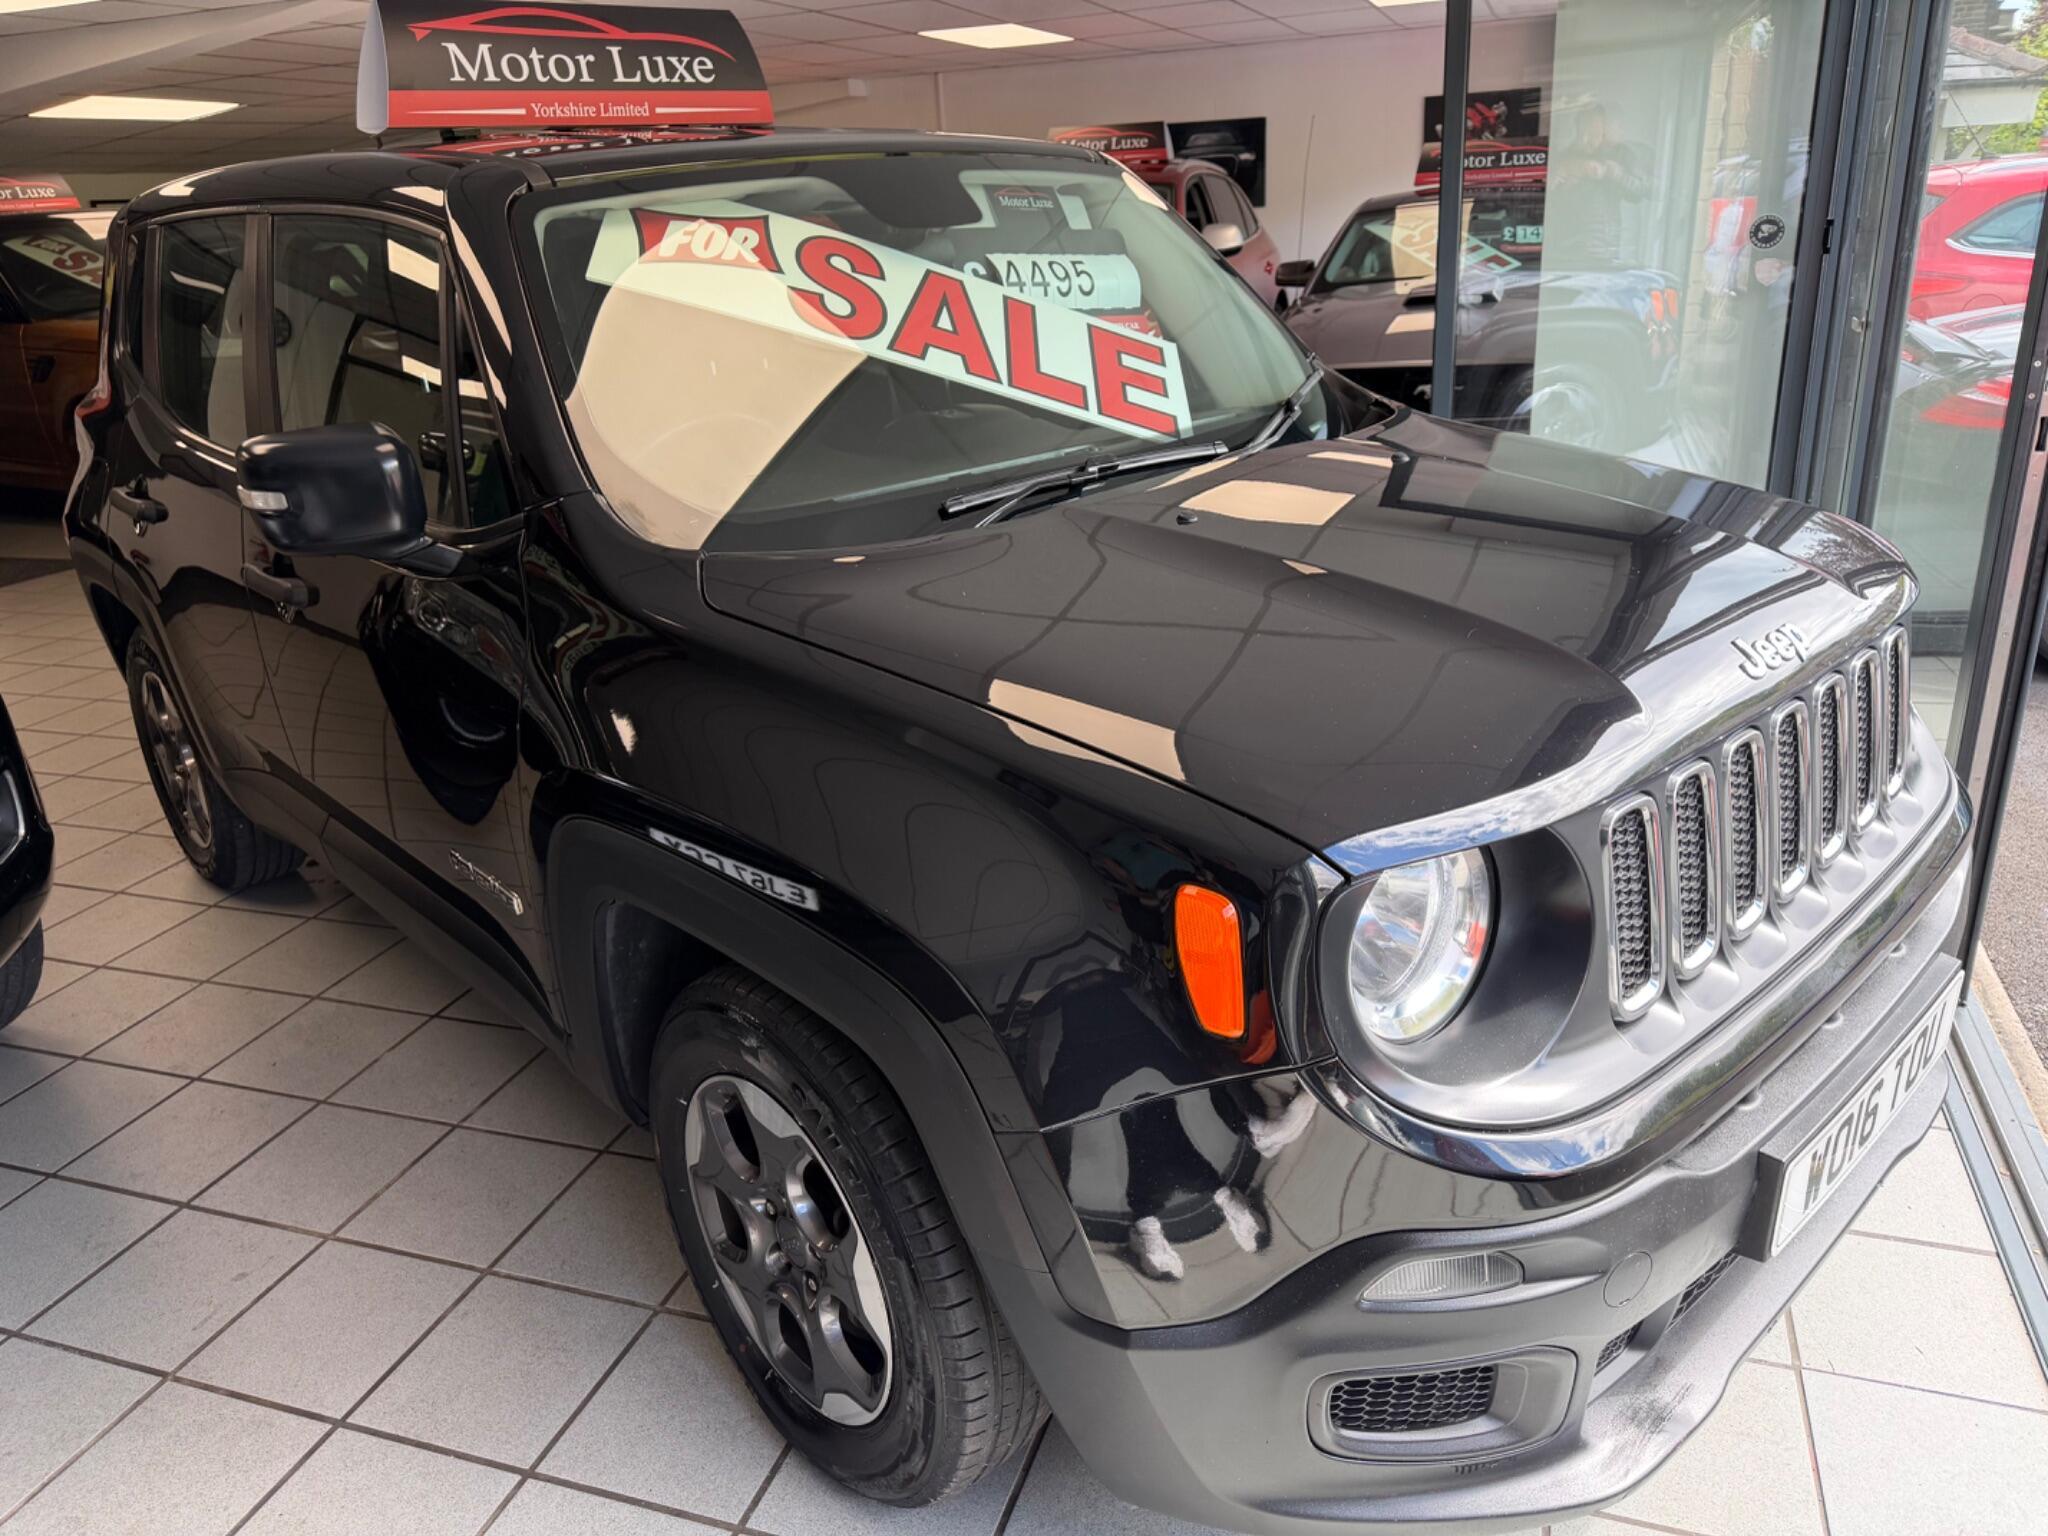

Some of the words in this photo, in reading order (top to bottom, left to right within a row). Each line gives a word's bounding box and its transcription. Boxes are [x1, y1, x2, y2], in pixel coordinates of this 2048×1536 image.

[442, 42, 596, 83] Motor
[605, 46, 716, 84] Luxe
[530, 101, 597, 118] Yorkshire
[599, 101, 650, 117] Limited
[1111, 136, 1149, 150] Luxe
[1500, 152, 1546, 166] Luxe
[15, 186, 57, 199] Luxe
[659, 219, 764, 267] FOR
[786, 235, 1180, 438] SALE
[1730, 622, 1811, 680] Jeep
[1803, 1078, 1884, 1214] WO16
